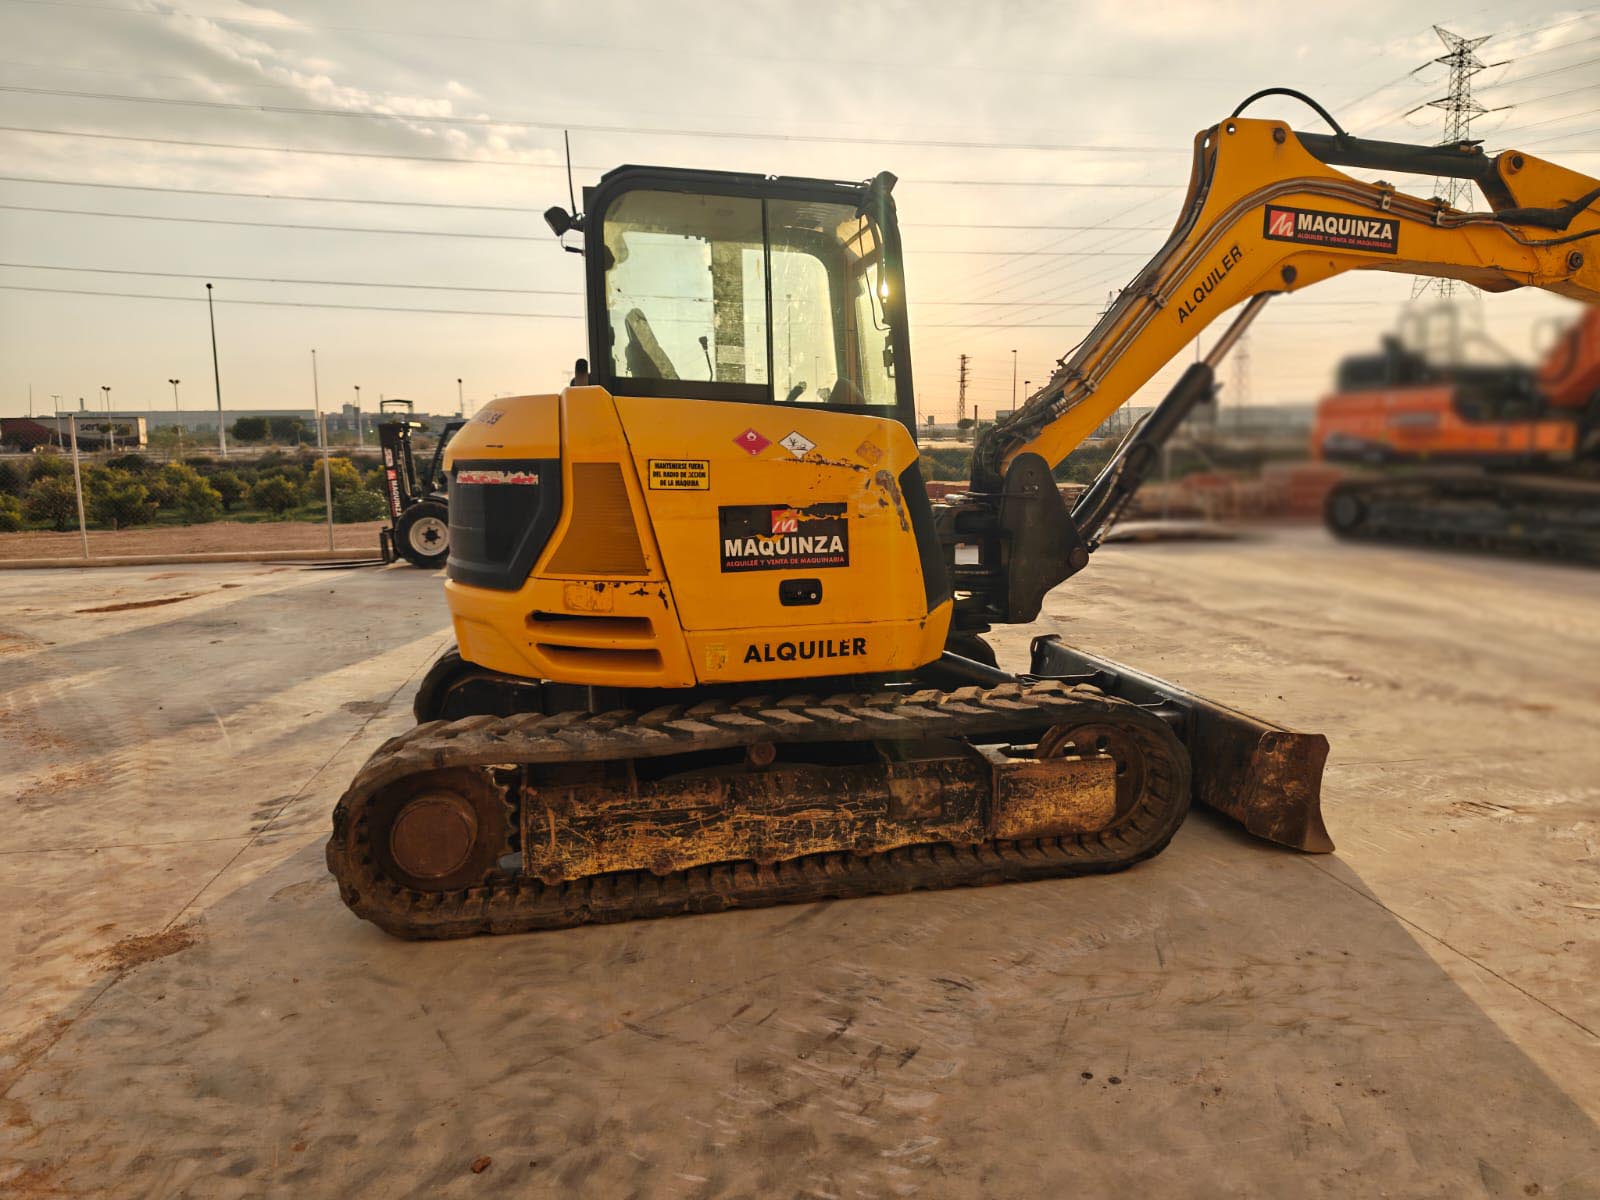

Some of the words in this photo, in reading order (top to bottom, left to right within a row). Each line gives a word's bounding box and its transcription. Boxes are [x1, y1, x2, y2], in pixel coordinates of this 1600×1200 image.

[1298, 213, 1393, 240] MAQUINZA
[1178, 245, 1243, 324] ALQUILER
[724, 535, 844, 557] MAQUINZA
[800, 556, 844, 564] MAQUINARIA
[743, 638, 867, 664] ALQUILER
